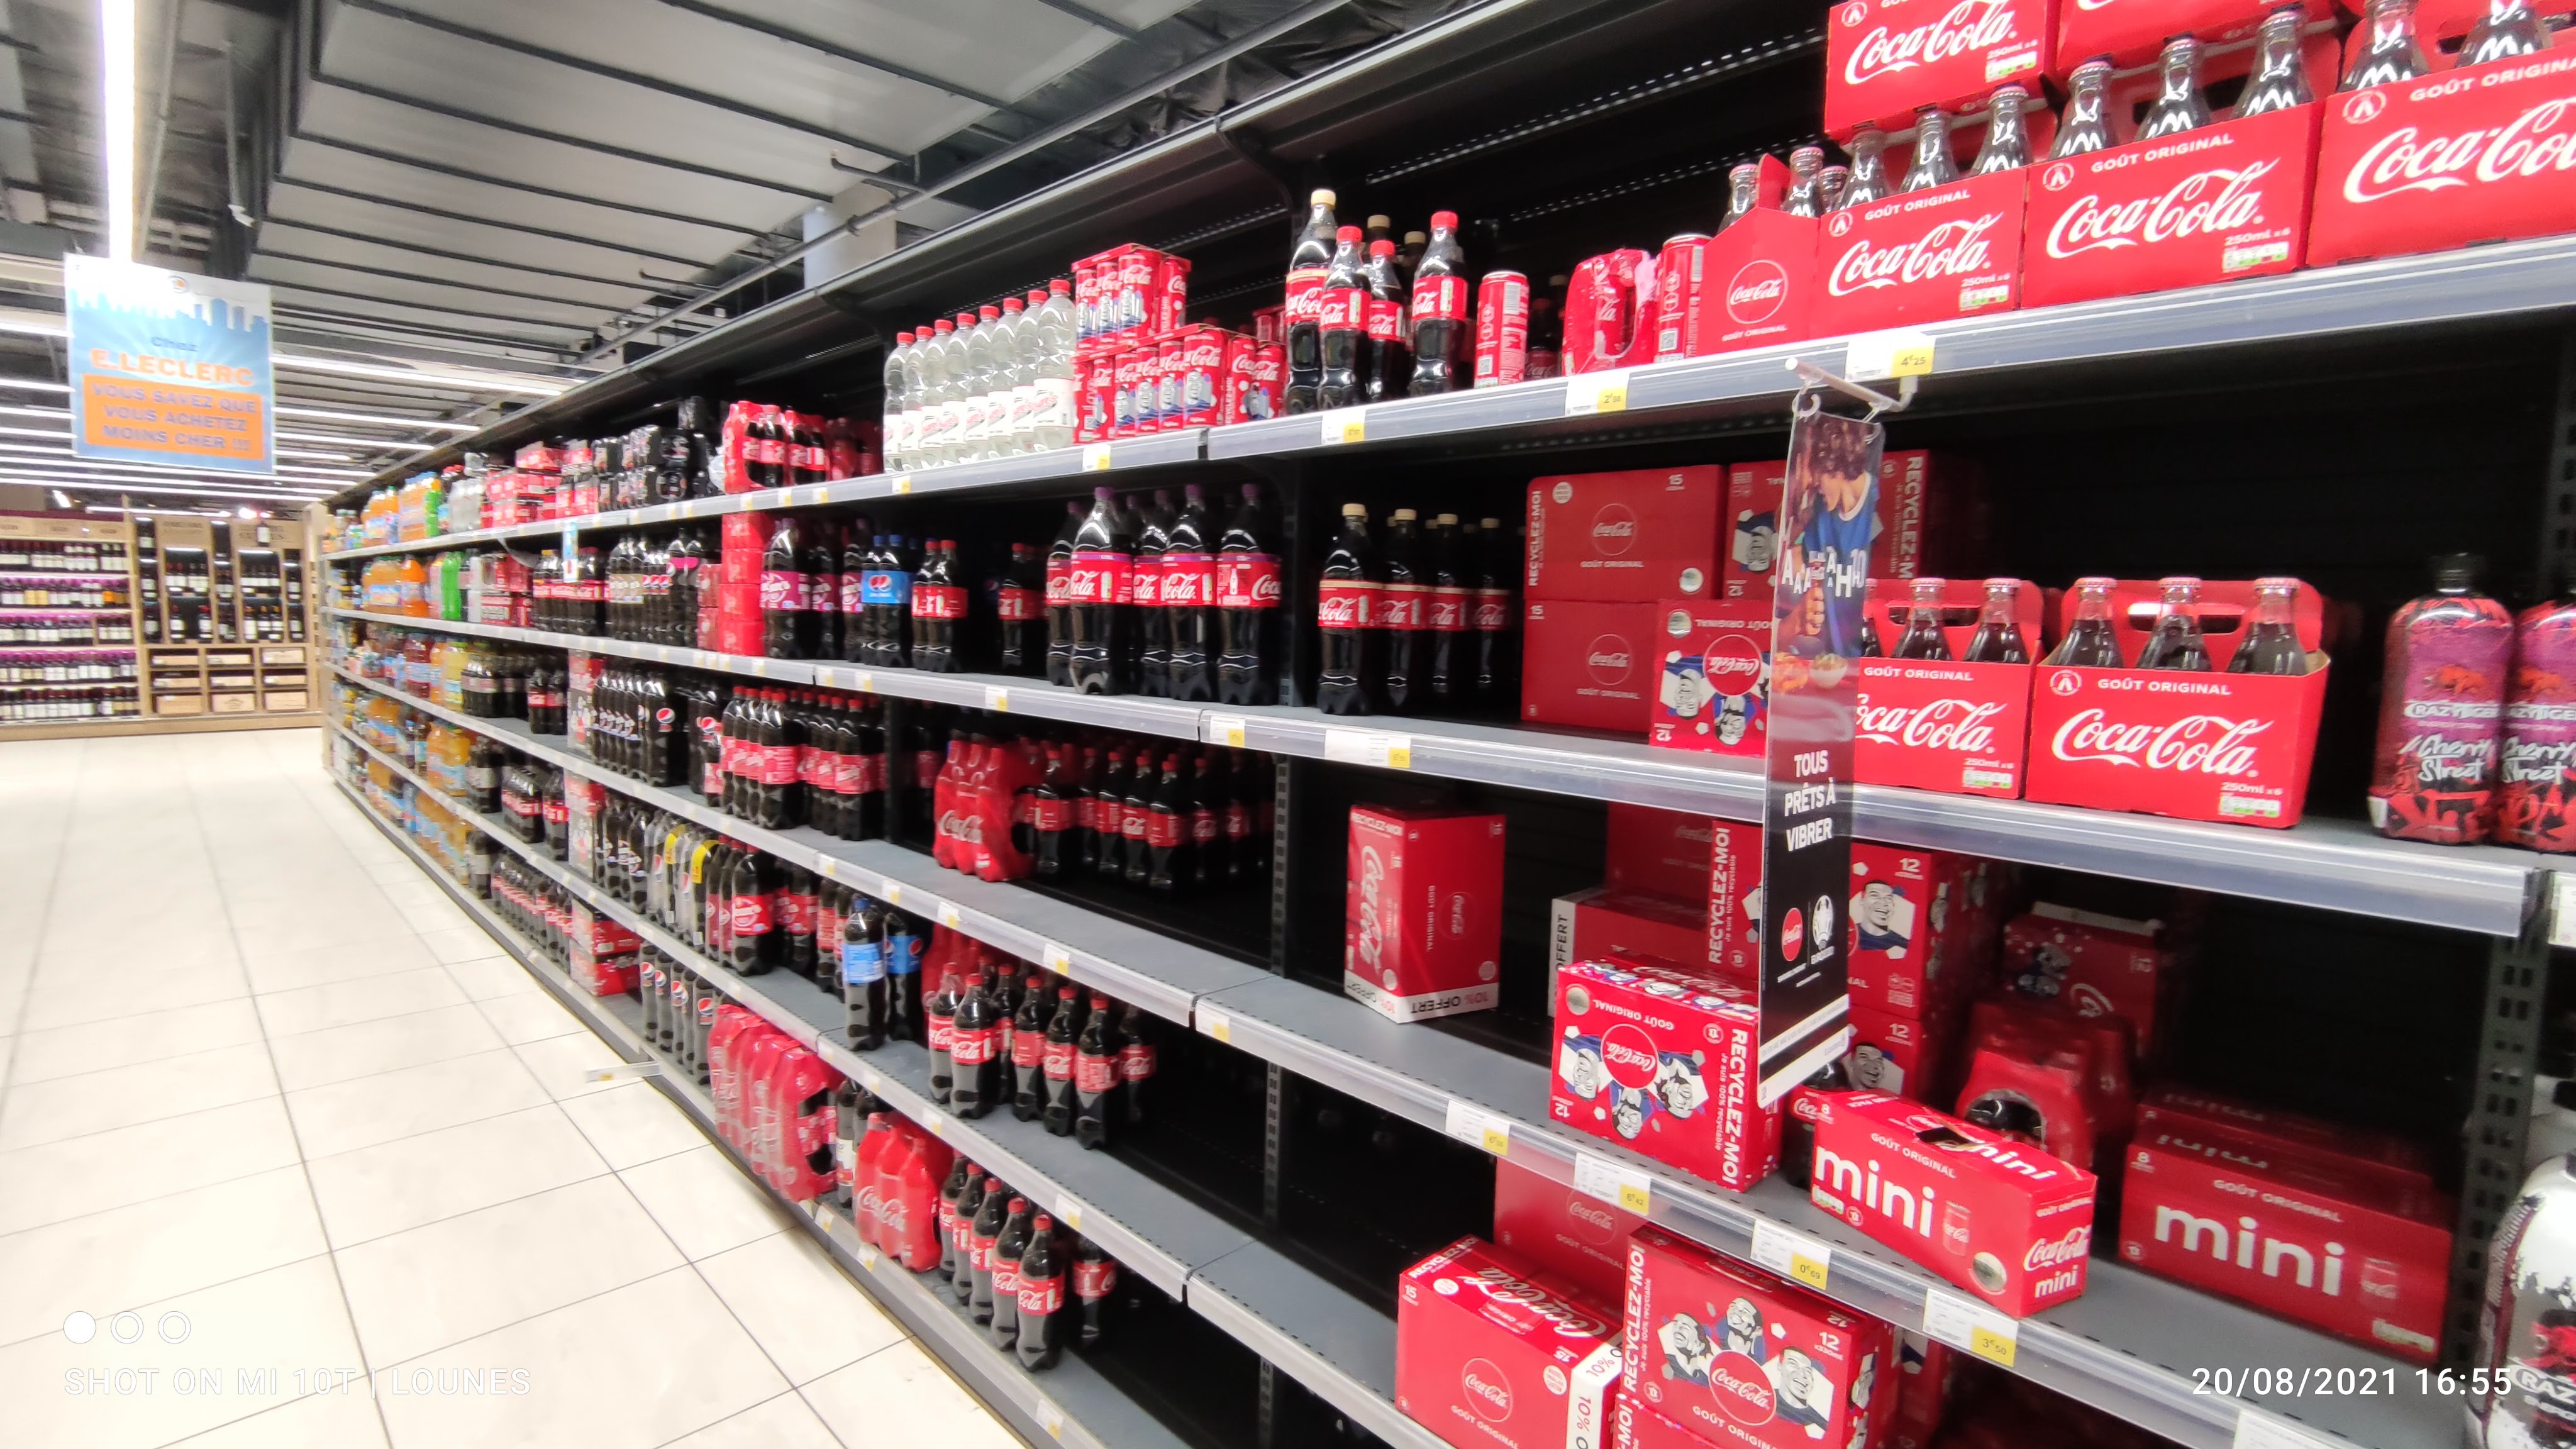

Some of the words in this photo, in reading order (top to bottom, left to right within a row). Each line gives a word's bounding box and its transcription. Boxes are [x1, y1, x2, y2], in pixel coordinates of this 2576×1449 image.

[2411, 77, 2475, 102] GOÛT
[2481, 57, 2576, 87] ORIGINA
[2090, 151, 2140, 174] GOÛT
[2145, 133, 2234, 163] ORIGINAL
[2343, 97, 2576, 203] Coca-Co
[1863, 200, 1901, 222] GOÛT
[1904, 189, 1971, 212] ORIGINAL
[2046, 157, 2280, 258] Coca-Cola
[1828, 211, 2005, 296] Coca-Cola
[1730, 279, 1784, 305] Coca-Cola
[92, 382, 145, 401] VOUS
[153, 390, 213, 408] SAVEZ
[219, 398, 257, 414] QUE
[103, 404, 157, 422] VOUS
[164, 412, 247, 431] ACHETEZ
[102, 425, 168, 443] MOINS
[174, 432, 226, 448] CHER
[1593, 521, 1635, 538] Coca-Cola
[1898, 456, 1924, 579] RECYCLEZ-M
[1588, 652, 1630, 668] Coca-Cola
[1707, 656, 1760, 677] Coca-Cola
[1864, 665, 1902, 679] GOÛT
[1905, 669, 1974, 682] ORIGINAL
[2097, 677, 2145, 692] GOÛT
[2148, 681, 2233, 696] ORIGINAL
[2051, 708, 2274, 778] Coca-Cola
[1794, 749, 1829, 779] TOUS
[2418, 757, 2485, 781] Street
[2501, 760, 2568, 784] Street
[1784, 781, 1824, 818] PRÊTS
[1825, 776, 1837, 806] À
[2221, 781, 2263, 795] 250ml
[1785, 818, 1834, 852] VIBRER
[1899, 857, 1921, 873] 12
[1708, 827, 1732, 965] RECYCLEZ-MOI
[1411, 996, 1461, 1014] OFFERT
[1592, 999, 1642, 1021] ORIGINAL
[1644, 1015, 1675, 1031] GOÛT
[1889, 1023, 1910, 1038] 12
[1604, 1041, 1657, 1072] Coca-Cola
[1555, 1102, 1571, 1118] 12
[1722, 1028, 1749, 1185] RECYCLEZ-MOI
[1821, 1103, 1831, 1115] 8
[1870, 1133, 1901, 1152] GOÛT
[1902, 1147, 1957, 1179] ORIGINAL
[1814, 1145, 1936, 1238] mini
[2212, 1179, 2258, 1198] GOÛT
[2262, 1193, 2345, 1223] ORIGINAL
[1570, 1202, 1614, 1230] Coca-Cola
[1407, 1236, 1478, 1279] RECYCLEZ-MOI
[2023, 1225, 2092, 1272] Coca-Cola
[2153, 1204, 2346, 1297] mini
[1405, 1284, 1417, 1299] 15
[2035, 1265, 2079, 1299] mini
[1623, 1244, 1646, 1393] RECYCLEZ-MOI
[1819, 1331, 1841, 1348] 12
[1585, 1357, 1614, 1377] 10%
[1464, 1373, 1511, 1410] Coca-Cola
[1711, 1367, 1772, 1411] Coca-Cola
[1451, 1404, 1475, 1424] GOÛT
[1576, 1395, 1592, 1433] 10%
[1692, 1405, 1725, 1428] GOÛT
[1728, 1424, 1777, 1449] ORIGIN
